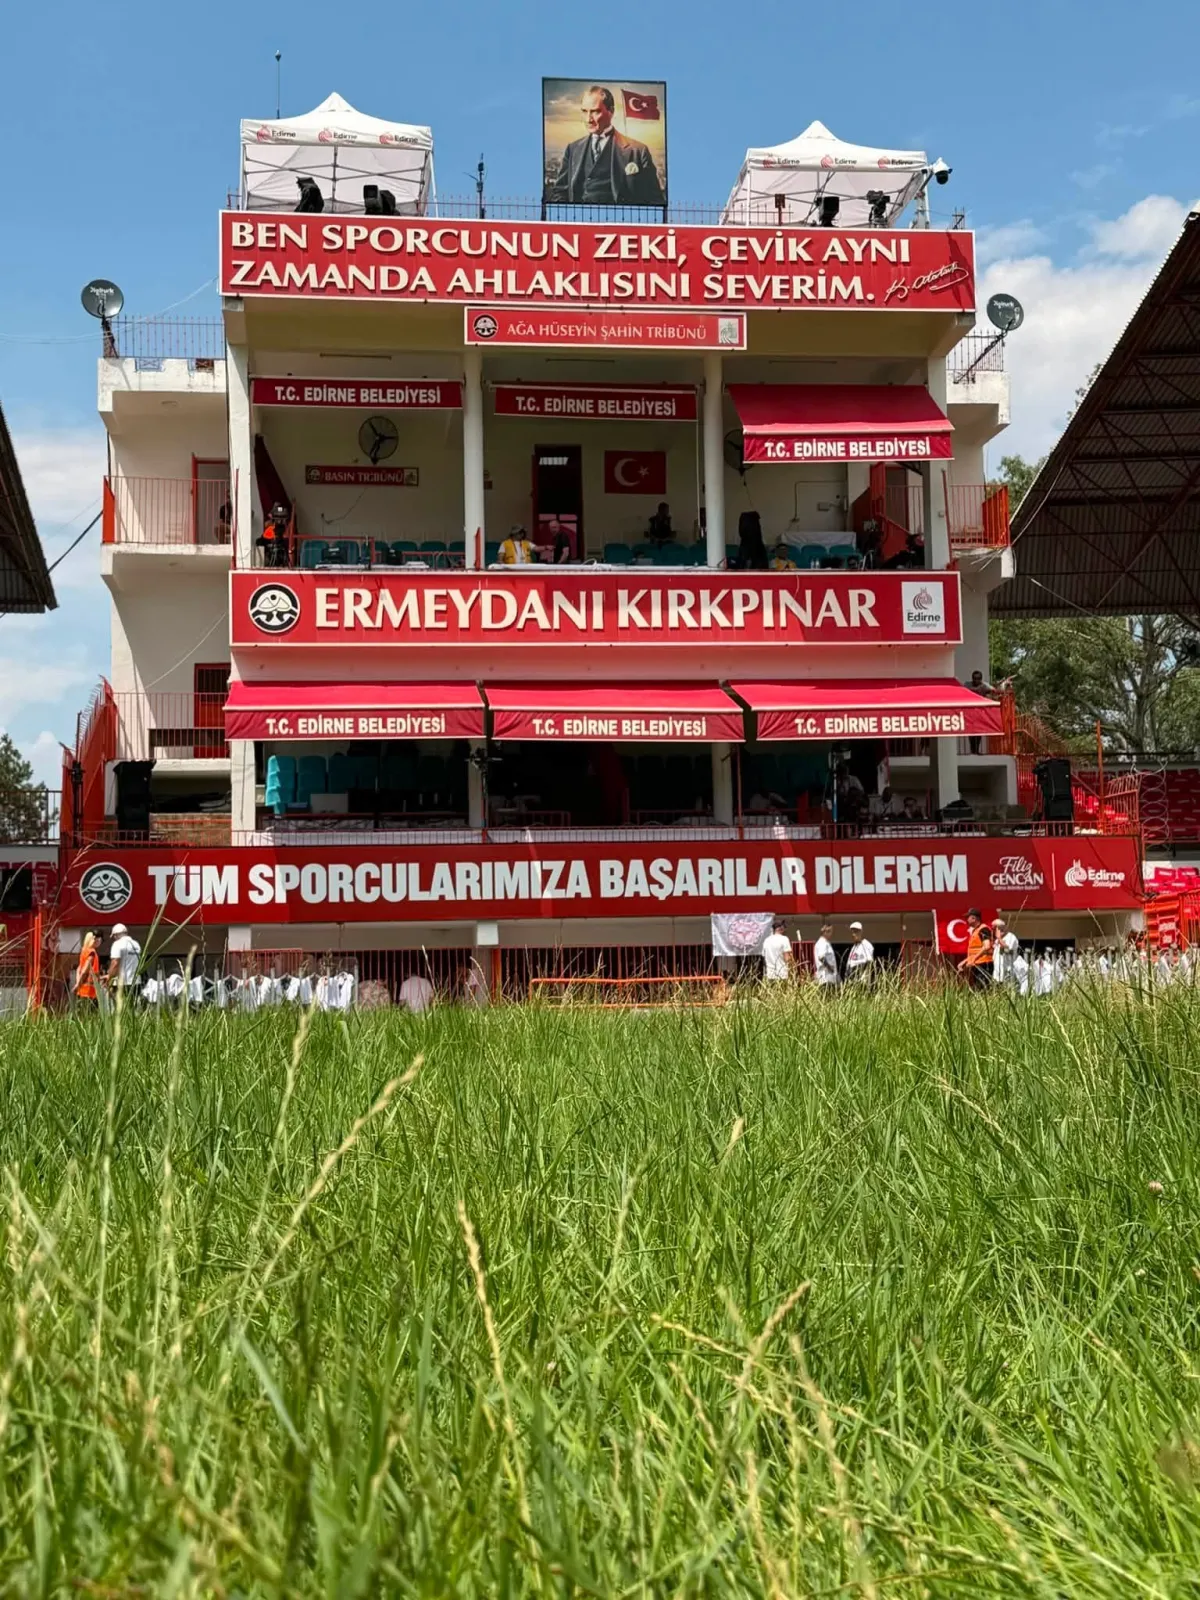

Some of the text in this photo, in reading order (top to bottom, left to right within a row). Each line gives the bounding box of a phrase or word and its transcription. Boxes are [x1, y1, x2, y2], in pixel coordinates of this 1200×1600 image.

[271, 130, 297, 139] Edirne
[333, 132, 358, 140] Edirne
[777, 157, 800, 165] Edirne
[834, 157, 858, 165] Edirne
[231, 221, 910, 268] BEN SPORCUNUN ZEKİ, ÇEVİK AYNI
[229, 261, 876, 301] ZAMANDA AHLAKLISINI SEVERİM.
[507, 321, 707, 341] AĞA HÜSEYİN ŞAHİN TRİBÜNÜ
[275, 384, 441, 404] T.C. EDİRNE BELEDİYESİ
[516, 395, 676, 416] T.C. EDİRNE BELEDİYESİ
[764, 437, 931, 457] T.C. EDİRNE BELEDİYESİ
[324, 471, 355, 482] BASIN
[315, 587, 880, 630] ERMEYDANI KIRKPINAR
[907, 612, 941, 622] Edirne
[266, 713, 446, 734] T.C. EDİRNE BELEDİYESİ
[532, 716, 706, 736] T.C. EDİRNE BELEDİYESİ
[795, 711, 965, 734] T.C. EDİRNE BELEDİYESİ
[148, 854, 968, 905] TÜM SPORCULARIMIZA BAŞARILAR DİLERİM
[989, 872, 1045, 886] GENCAN
[1087, 868, 1126, 882] Edirne
